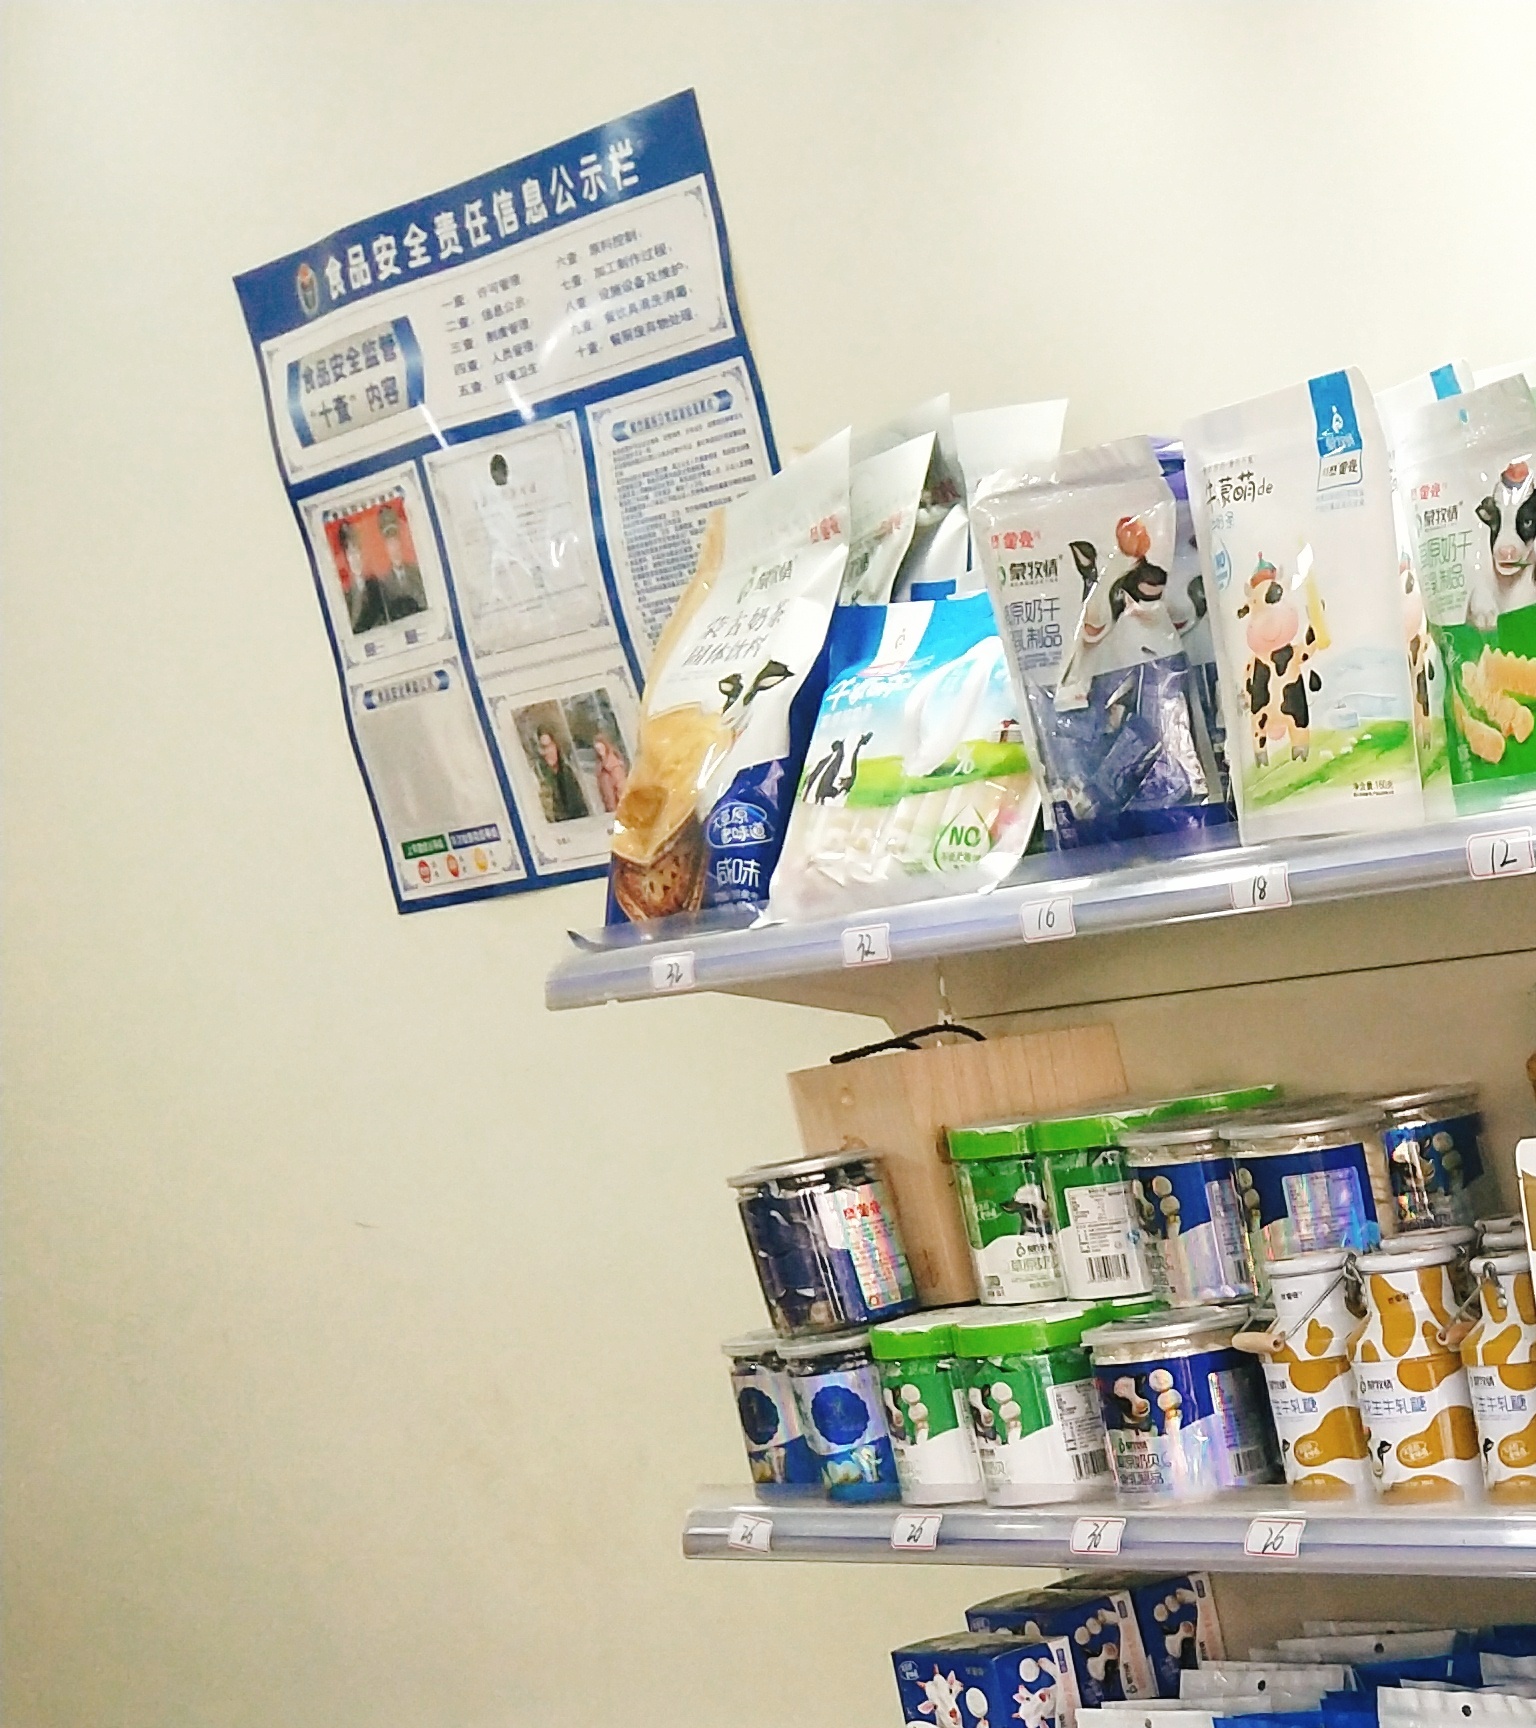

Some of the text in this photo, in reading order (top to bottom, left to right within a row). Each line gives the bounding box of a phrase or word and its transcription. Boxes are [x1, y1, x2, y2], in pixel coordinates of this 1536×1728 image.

[325, 138, 639, 300] 食品安全责任信息公示栏
[949, 826, 983, 847] NO
[715, 857, 761, 888] 咸味
[1491, 839, 1518, 875] 12
[1252, 875, 1268, 905] 18
[1038, 899, 1057, 930] 16
